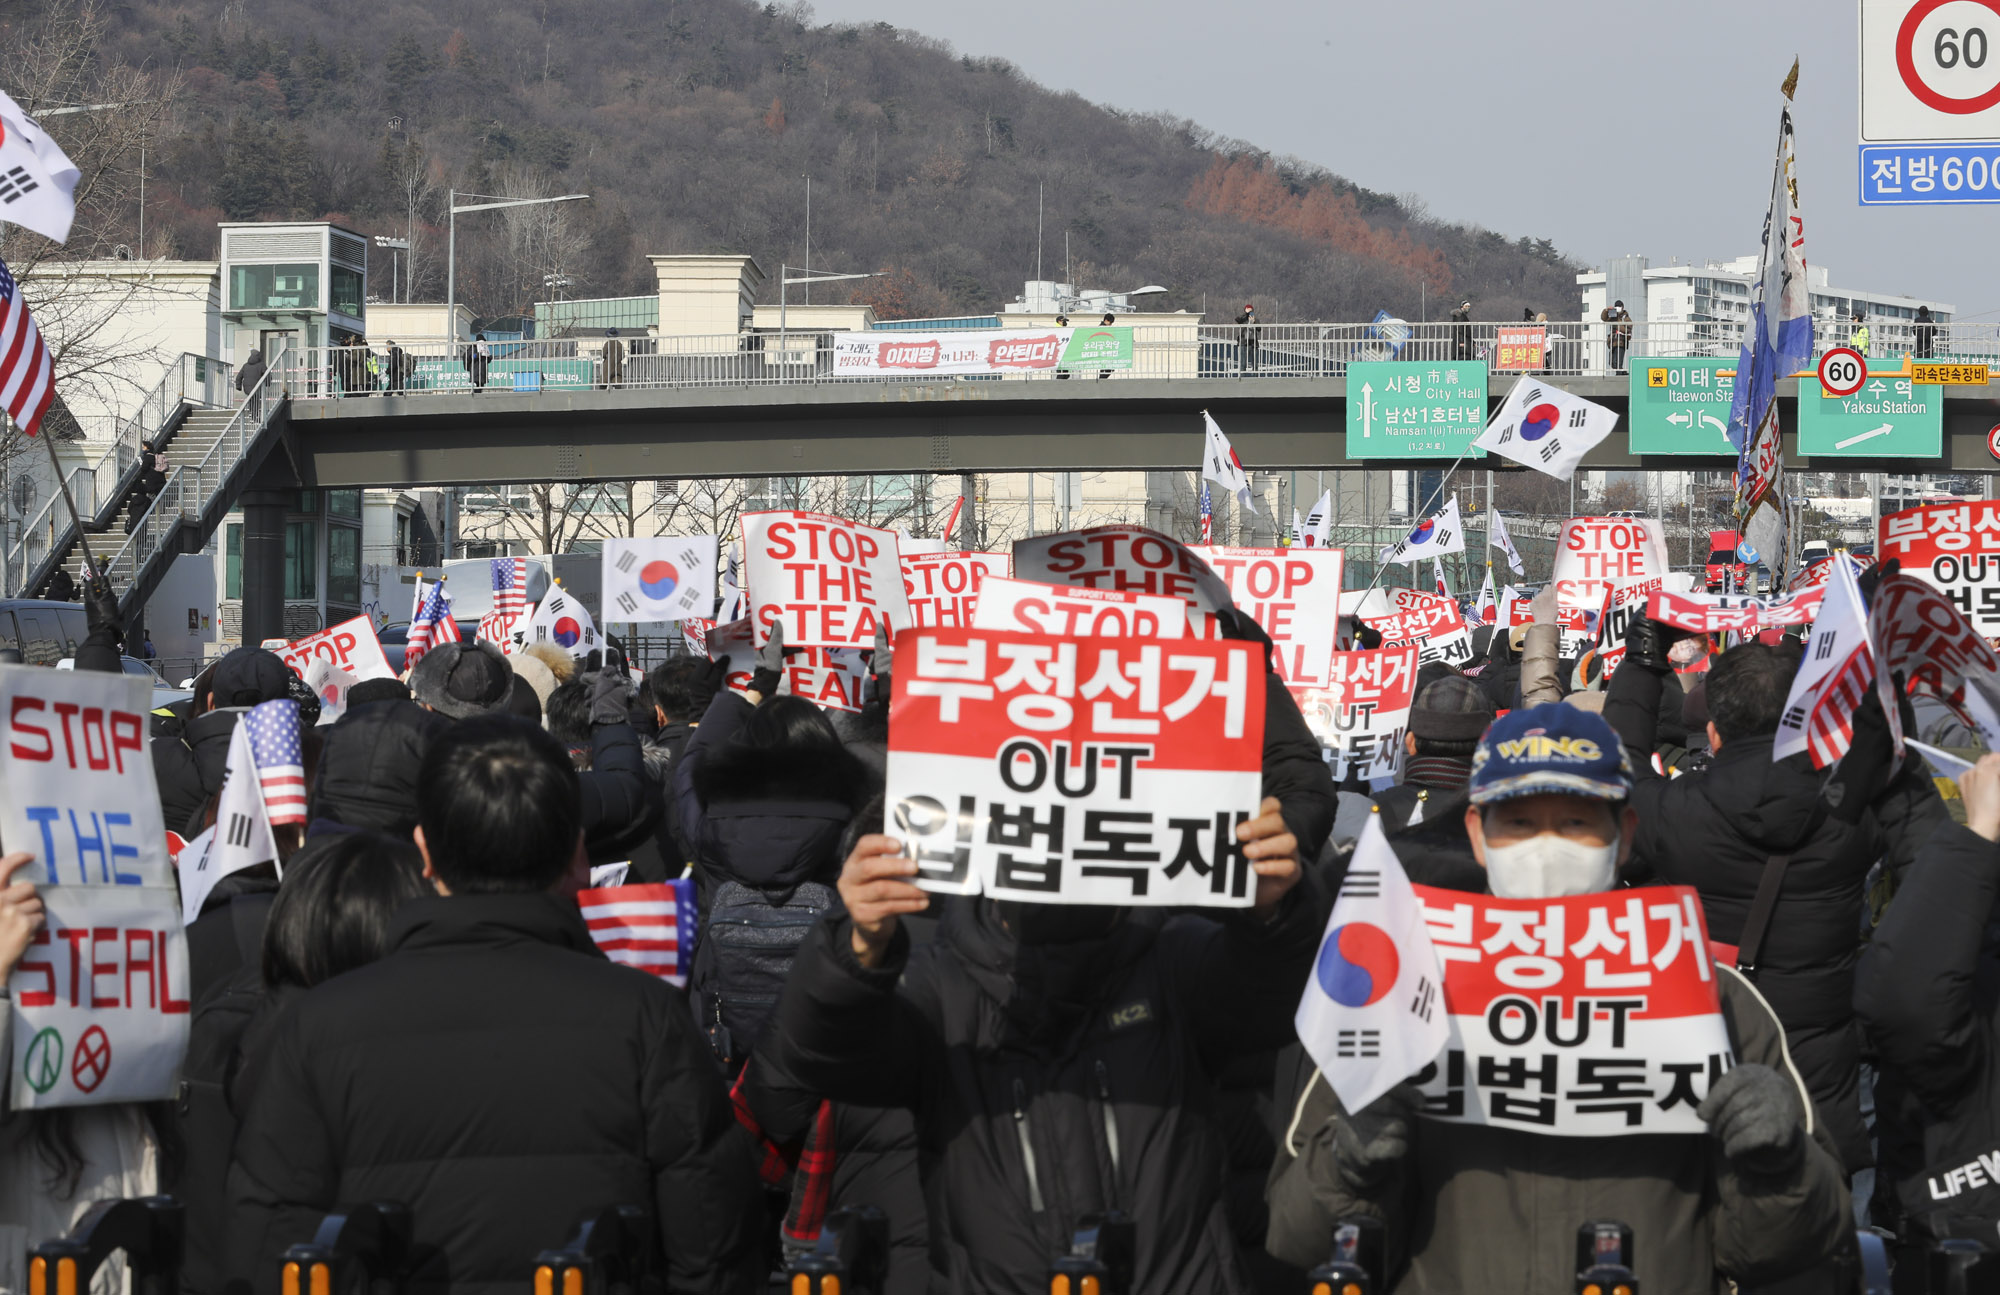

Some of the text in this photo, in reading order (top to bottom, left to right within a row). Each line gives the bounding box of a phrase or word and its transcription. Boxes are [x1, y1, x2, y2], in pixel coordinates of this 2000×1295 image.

[1934, 28, 1987, 68] 60
[886, 347, 936, 364] 이재명
[1829, 362, 1857, 382] 60
[1915, 367, 1985, 382] 과속단속장비
[1385, 375, 1421, 393] 시청
[1426, 388, 1480, 401] City Hall
[1668, 389, 1714, 402] Itaewon
[1853, 379, 1913, 400] 수역
[1385, 406, 1480, 424] 남산1호터널
[1842, 400, 1927, 414] Yaksu Station
[1385, 425, 1427, 436] Namsan
[1447, 425, 1480, 436] Tunnel
[806, 513, 845, 526] SUPPORT YOON
[1567, 525, 1647, 550] STOP
[1884, 506, 2000, 553] 부정선
[766, 521, 879, 568] STOP
[920, 553, 944, 561] SUPPORT
[1047, 533, 1210, 576] STOP
[1212, 558, 1314, 600] TOP
[1576, 551, 1645, 578] THE
[783, 563, 877, 606] THE
[1068, 588, 1125, 601] SUPPORT YOON
[1013, 597, 1160, 638] STOP
[1370, 602, 1456, 640] 정선거
[1884, 583, 1997, 673] TOP
[725, 667, 863, 710] SEAL
[906, 636, 1248, 739] 부정선거
[10, 695, 143, 775] STOP
[999, 740, 1151, 801] OUT
[26, 806, 142, 885] THE
[894, 794, 1250, 899] 입법독재
[1415, 894, 1711, 989] 부정선거
[16, 927, 190, 1014] STEAL
[1112, 1003, 1149, 1026] K2
[1487, 997, 1645, 1049] OUT
